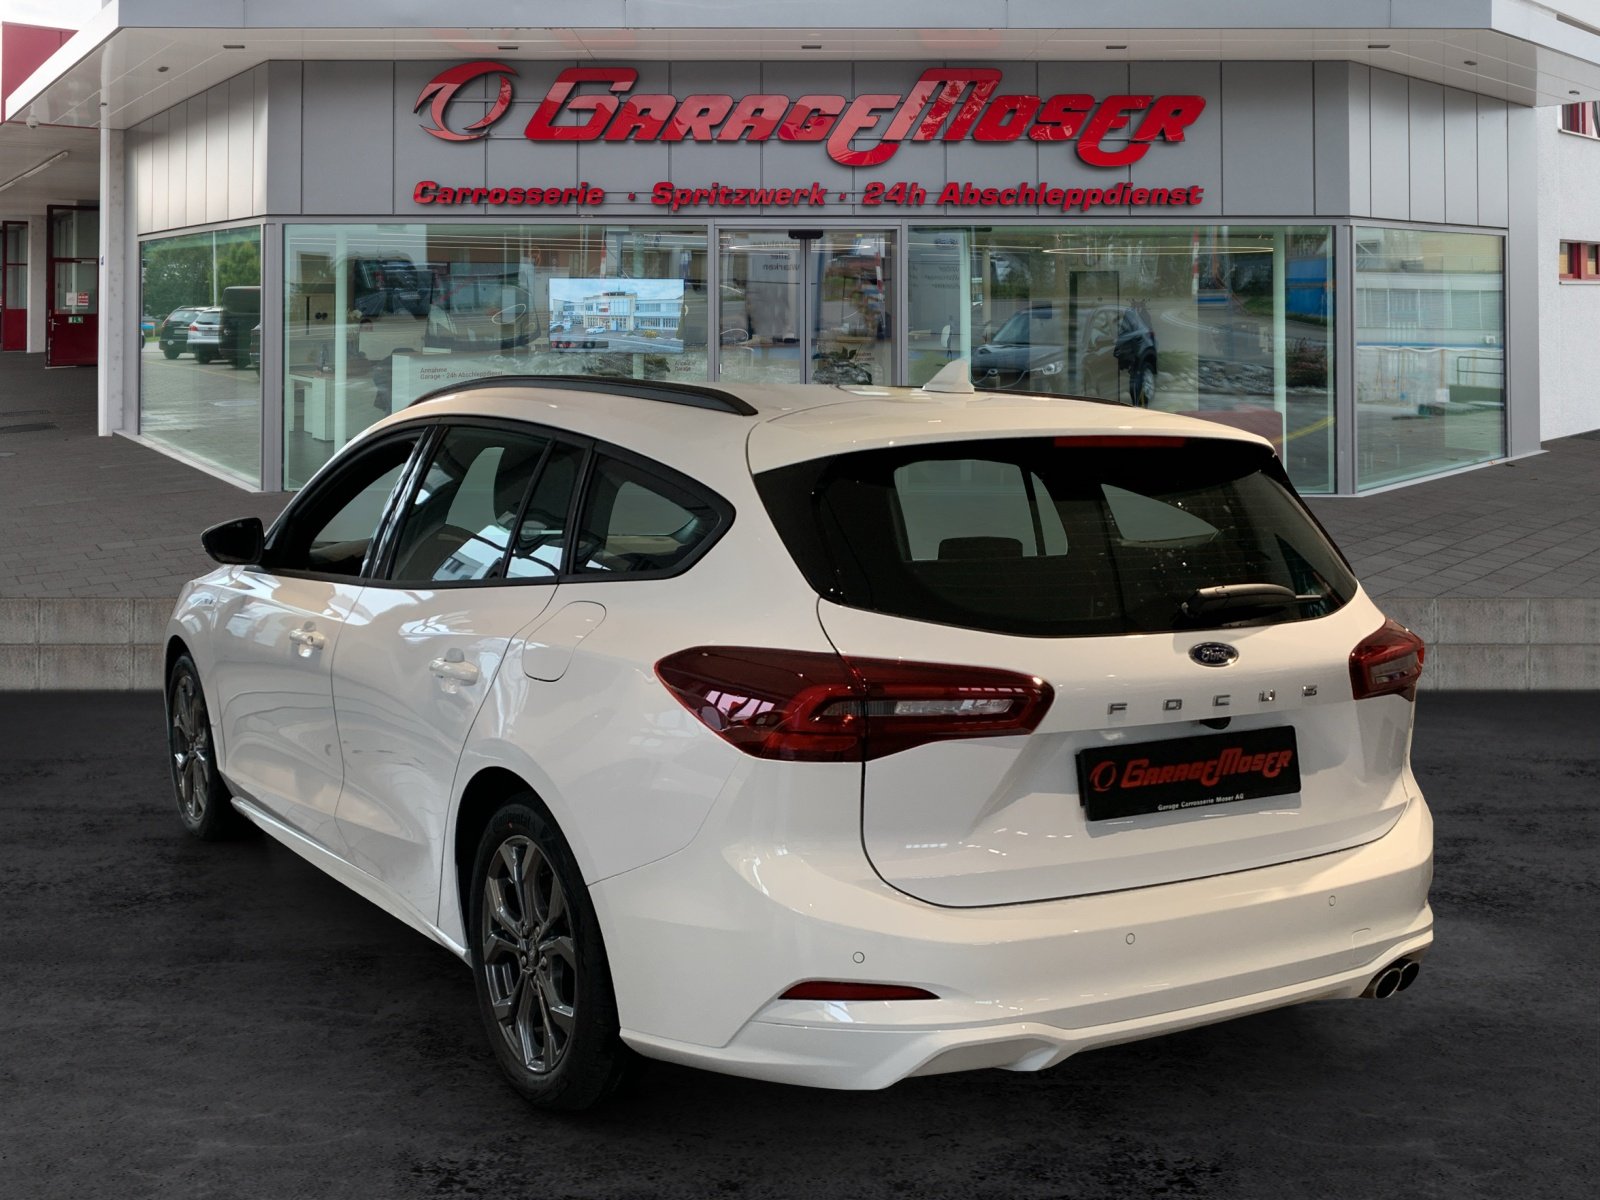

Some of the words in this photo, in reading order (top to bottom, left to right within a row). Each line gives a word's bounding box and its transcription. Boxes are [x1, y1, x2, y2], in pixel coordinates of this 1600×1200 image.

[413, 181, 605, 206] Carrosserie
[651, 181, 826, 211] Spritzwerk
[862, 182, 926, 206] 24h
[936, 182, 1204, 211] Abschleppdienst
[1107, 684, 1317, 715] FOCUS
[1158, 802, 1179, 811] Garage
[1181, 798, 1214, 808] Carrosserie
[1216, 795, 1234, 803] Moser
